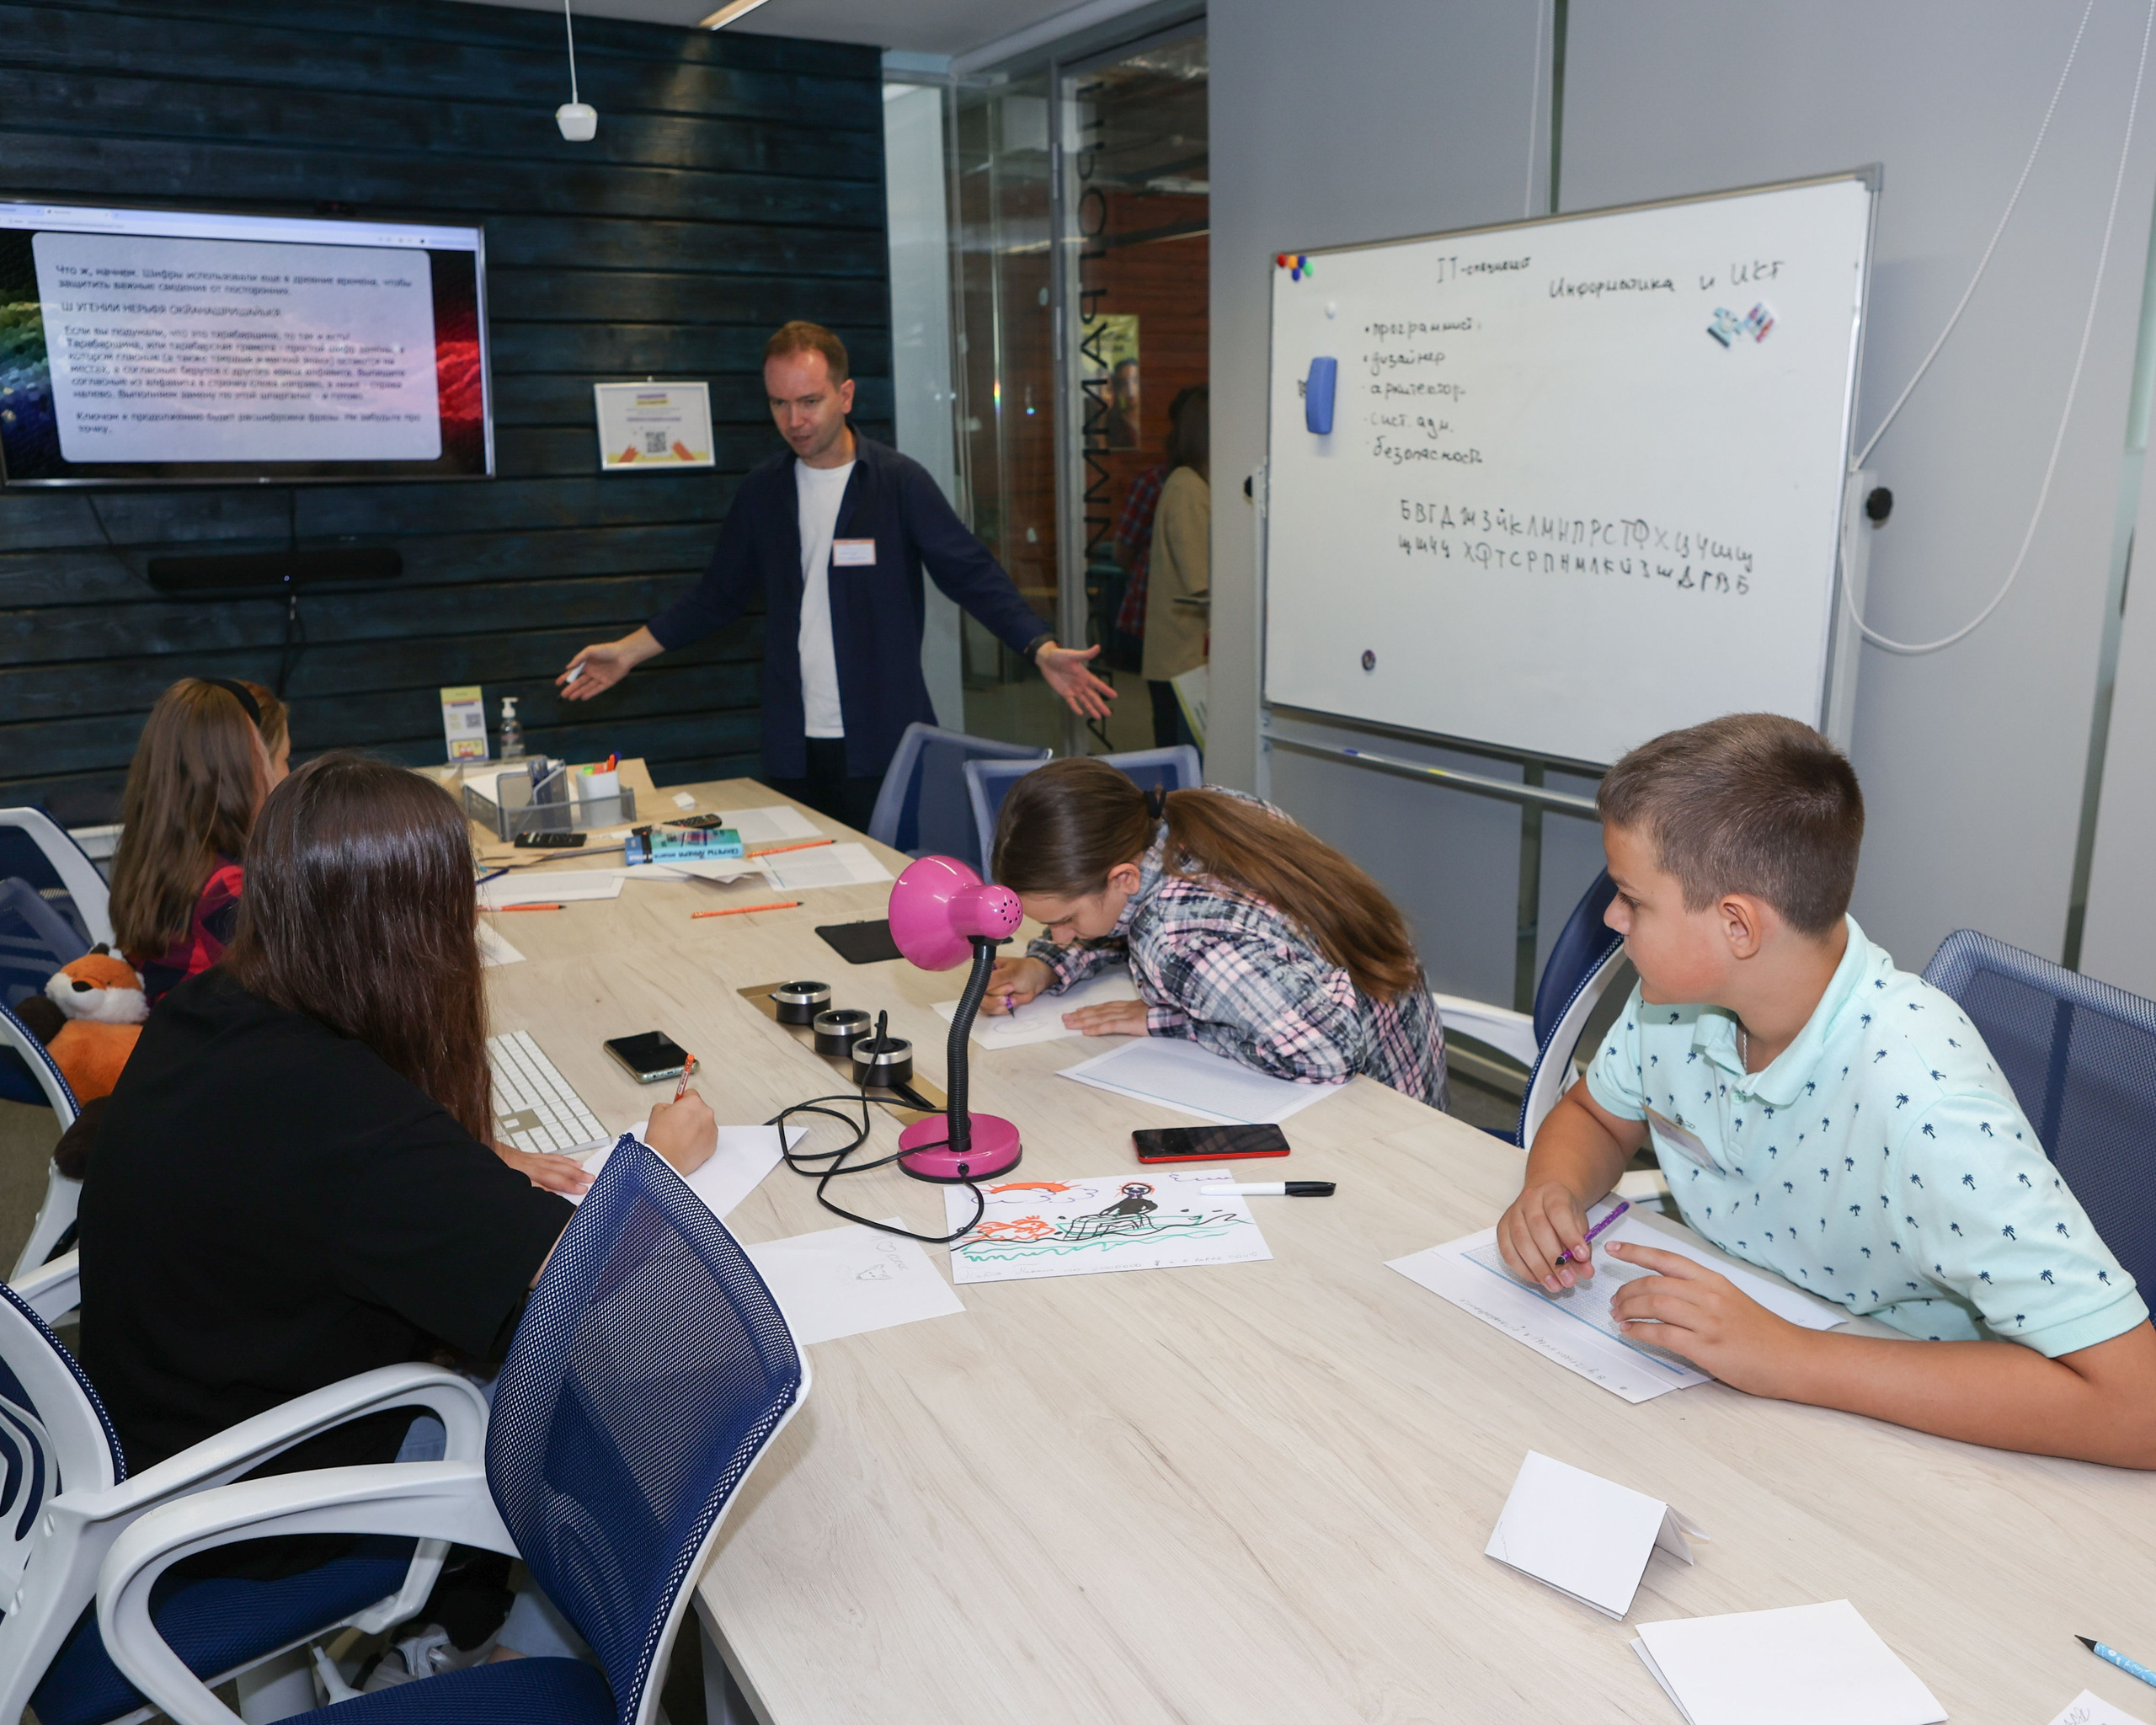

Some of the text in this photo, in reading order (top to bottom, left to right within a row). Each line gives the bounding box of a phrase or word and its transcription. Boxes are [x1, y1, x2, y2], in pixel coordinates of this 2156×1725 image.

[1548, 275, 1676, 299] Информатика
[1698, 275, 1716, 291] и
[1370, 349, 1446, 377] дизайнер
